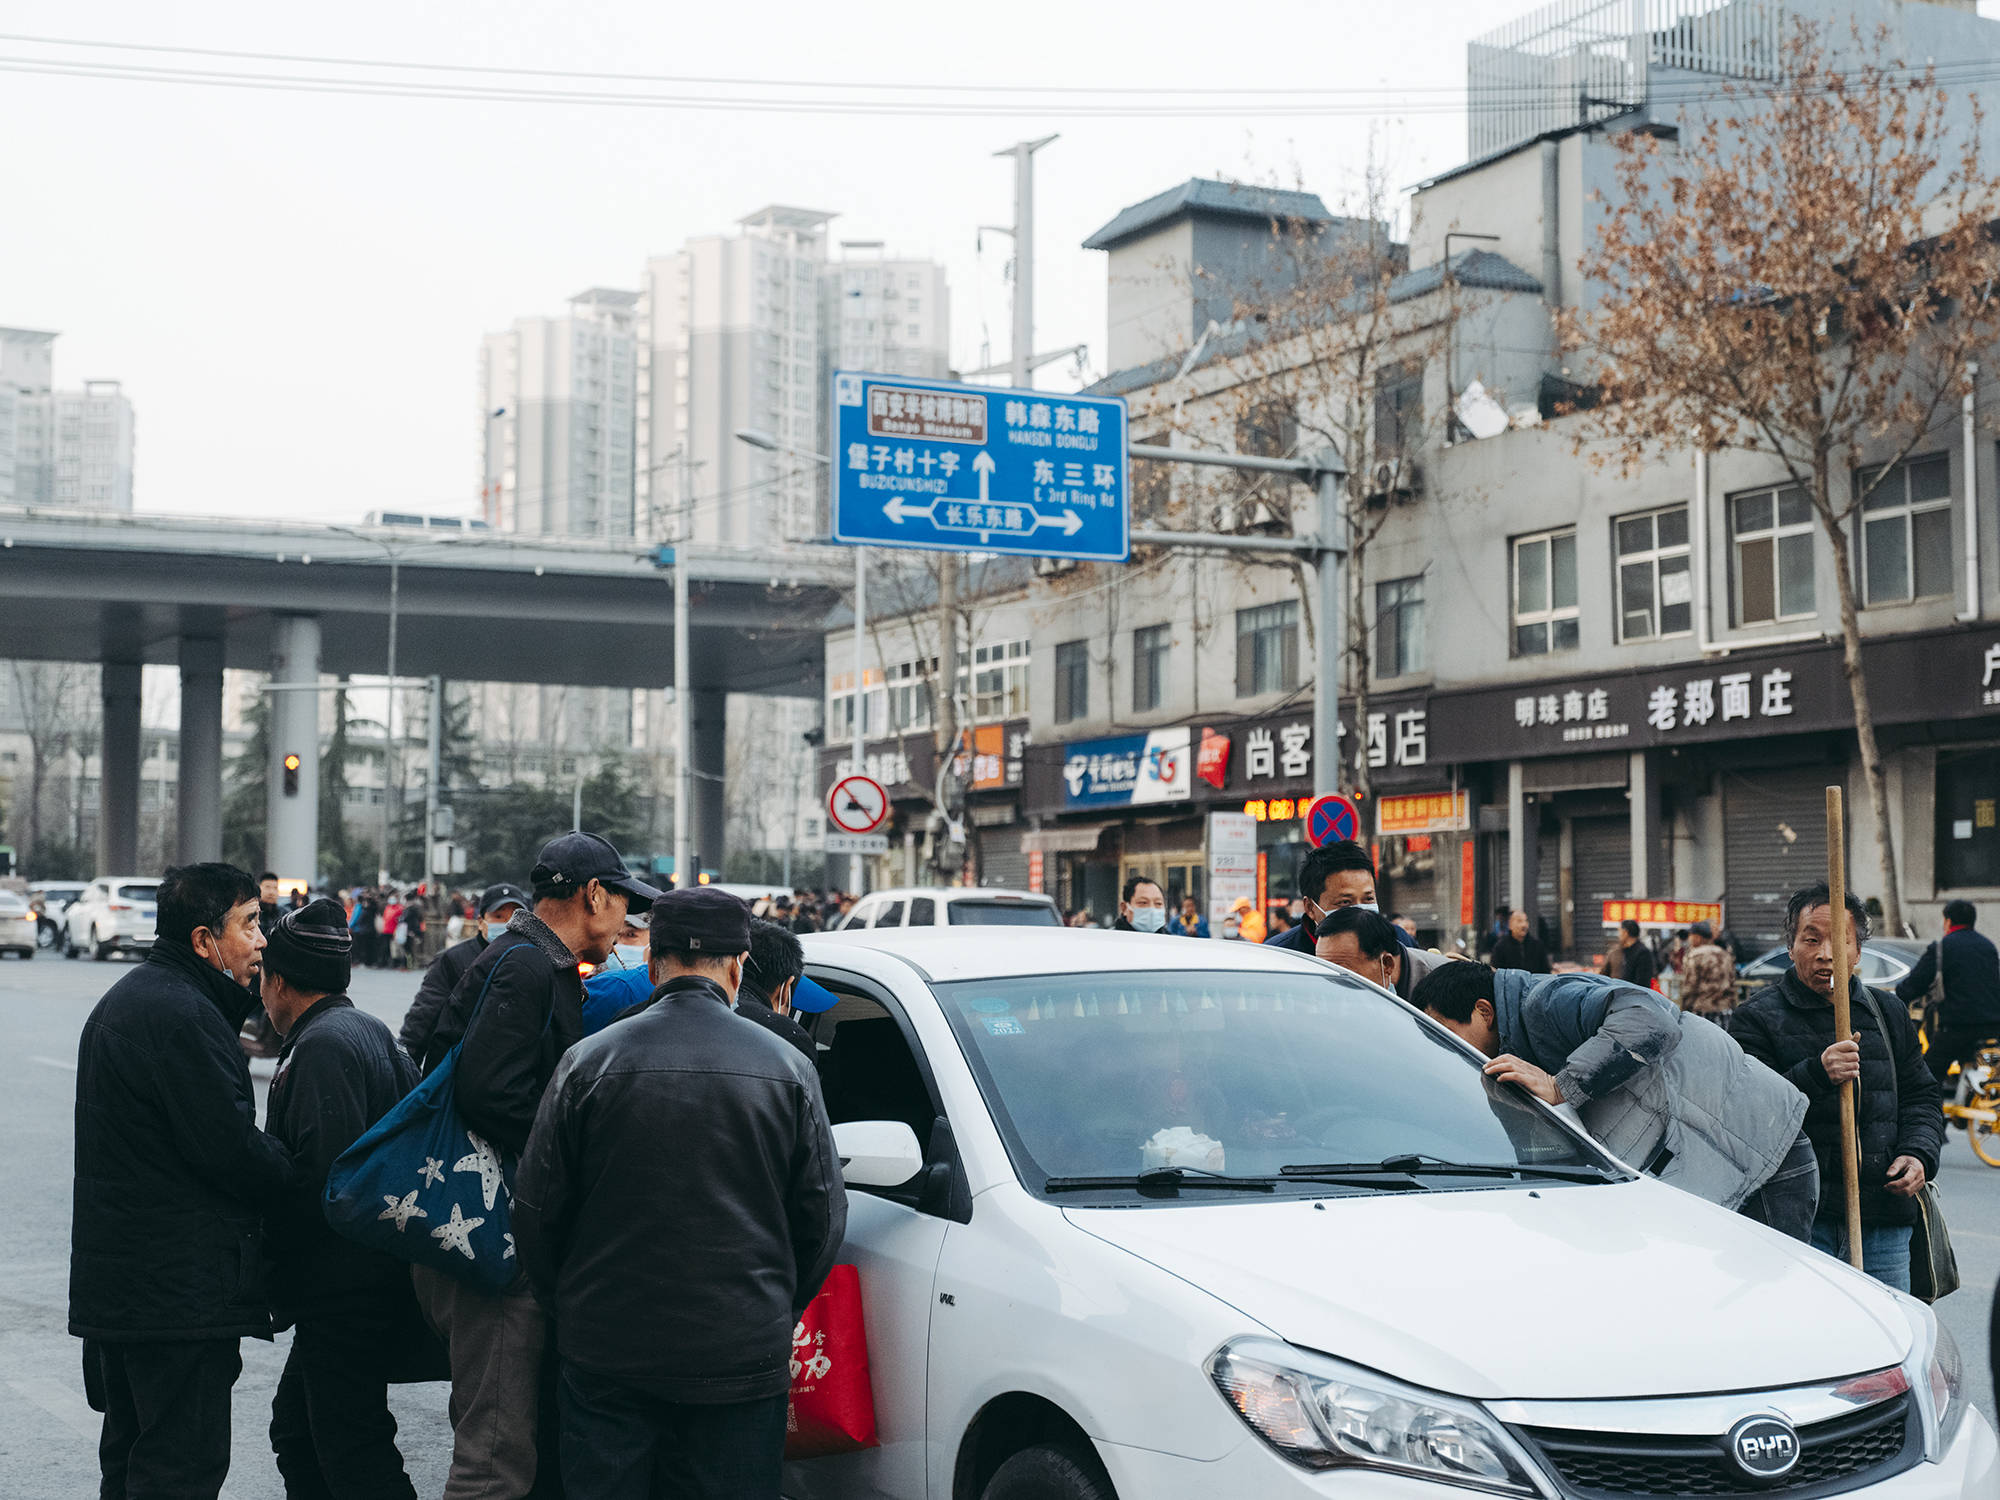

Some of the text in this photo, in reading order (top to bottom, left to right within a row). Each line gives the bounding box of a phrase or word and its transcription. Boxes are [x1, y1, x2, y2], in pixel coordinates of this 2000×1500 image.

[923, 423, 973, 439] Museum
[1005, 400, 1100, 434] 韩森东路
[848, 442, 960, 477] 堡子村十字
[1033, 459, 1115, 490] 东三环
[946, 504, 1022, 529] 长乐东路
[1071, 489, 1096, 510] Ring
[1100, 492, 1115, 507] Rd
[1515, 688, 1607, 727] 明珠商店
[1648, 668, 1792, 730] 老郑面庄
[1246, 709, 1426, 780] 尚客酒店
[1149, 747, 1176, 784] 5G
[1741, 1434, 1794, 1461] BYD
